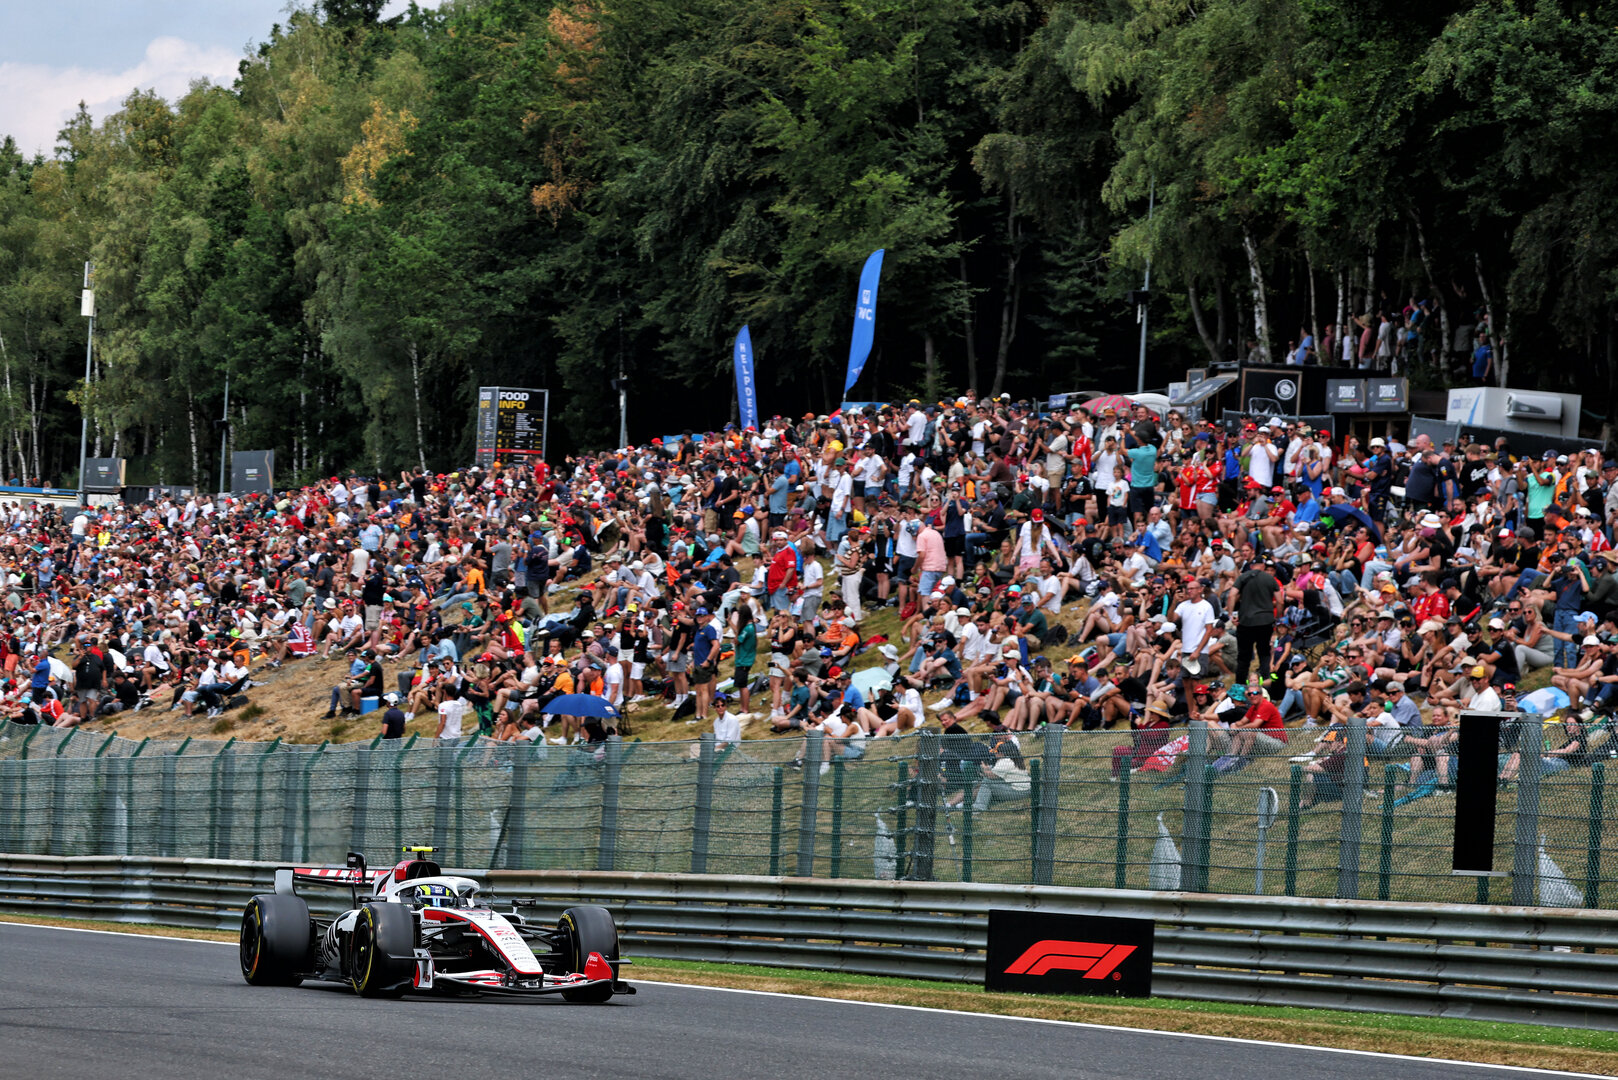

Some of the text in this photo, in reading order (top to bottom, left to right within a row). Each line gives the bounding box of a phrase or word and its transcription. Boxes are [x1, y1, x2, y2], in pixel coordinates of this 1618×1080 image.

[499, 391, 529, 401] FOOD
[499, 401, 525, 409] INFO
[1003, 939, 1138, 980] F1
